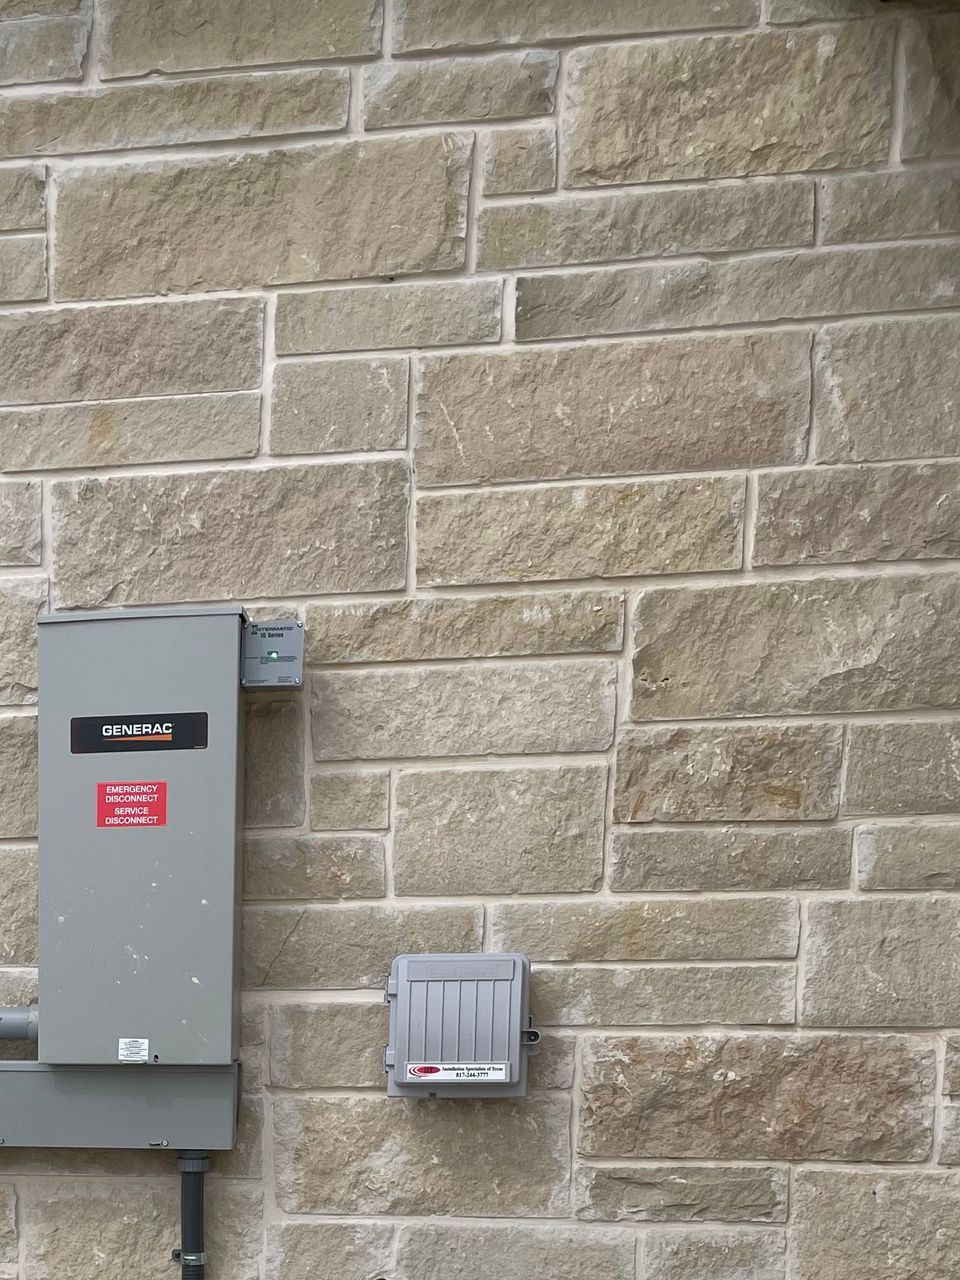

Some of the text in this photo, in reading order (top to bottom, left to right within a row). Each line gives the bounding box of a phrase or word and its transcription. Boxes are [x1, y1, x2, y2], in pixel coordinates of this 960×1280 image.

[251, 624, 294, 635] INTERMATIC
[102, 723, 173, 736] GENERAC
[106, 785, 158, 793] EMERGENCY
[105, 794, 158, 803] DISCONNECT
[105, 816, 158, 824] DISCONNECT
